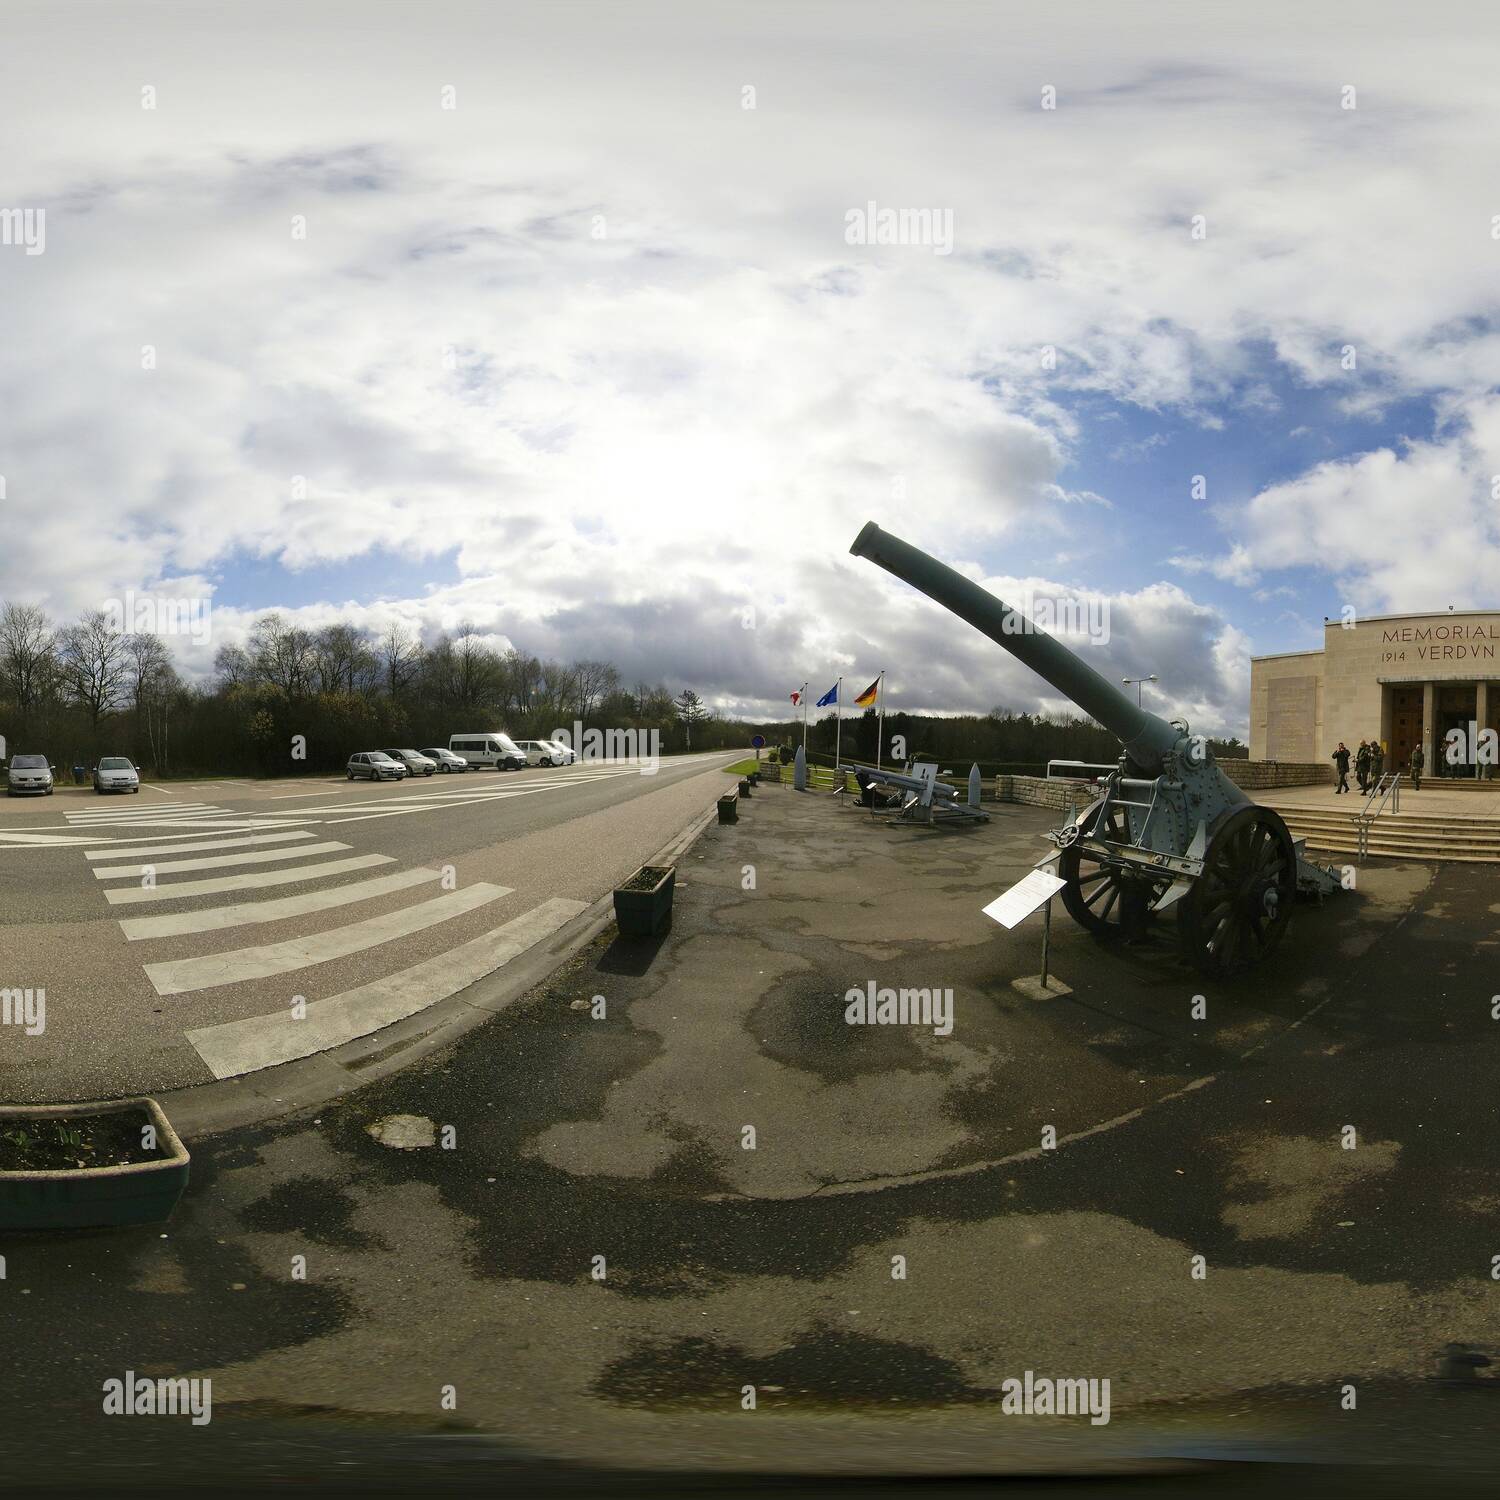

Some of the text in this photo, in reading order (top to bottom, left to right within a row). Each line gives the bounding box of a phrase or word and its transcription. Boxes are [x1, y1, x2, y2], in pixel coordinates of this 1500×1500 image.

[1383, 625, 1500, 643] MEMORIAL
[1381, 651, 1406, 663] 1914
[1417, 645, 1495, 660] VERDVN
